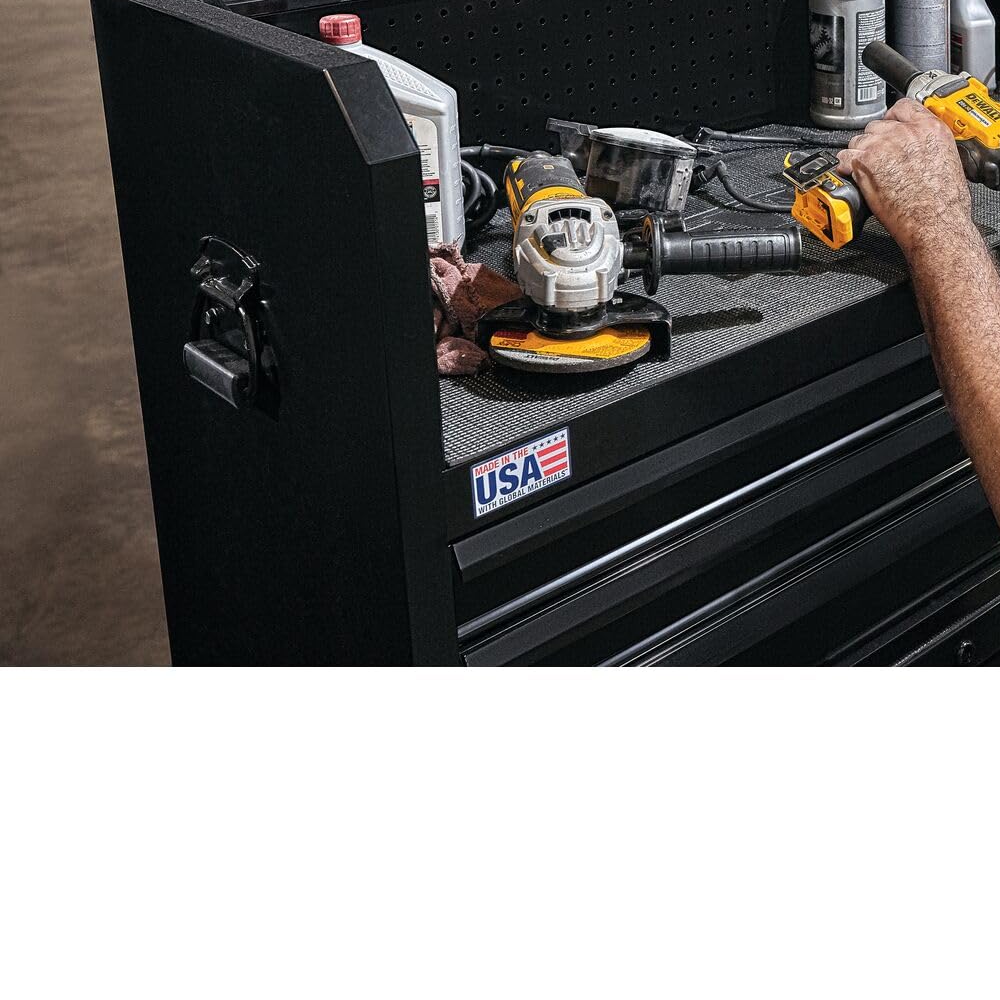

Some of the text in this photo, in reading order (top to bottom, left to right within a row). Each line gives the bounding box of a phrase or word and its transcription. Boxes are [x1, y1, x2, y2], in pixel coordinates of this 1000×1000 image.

[475, 447, 529, 477] MADE IN THE
[475, 453, 543, 505] USA
[478, 471, 566, 515] WITH GLOBAL MATERIALS
